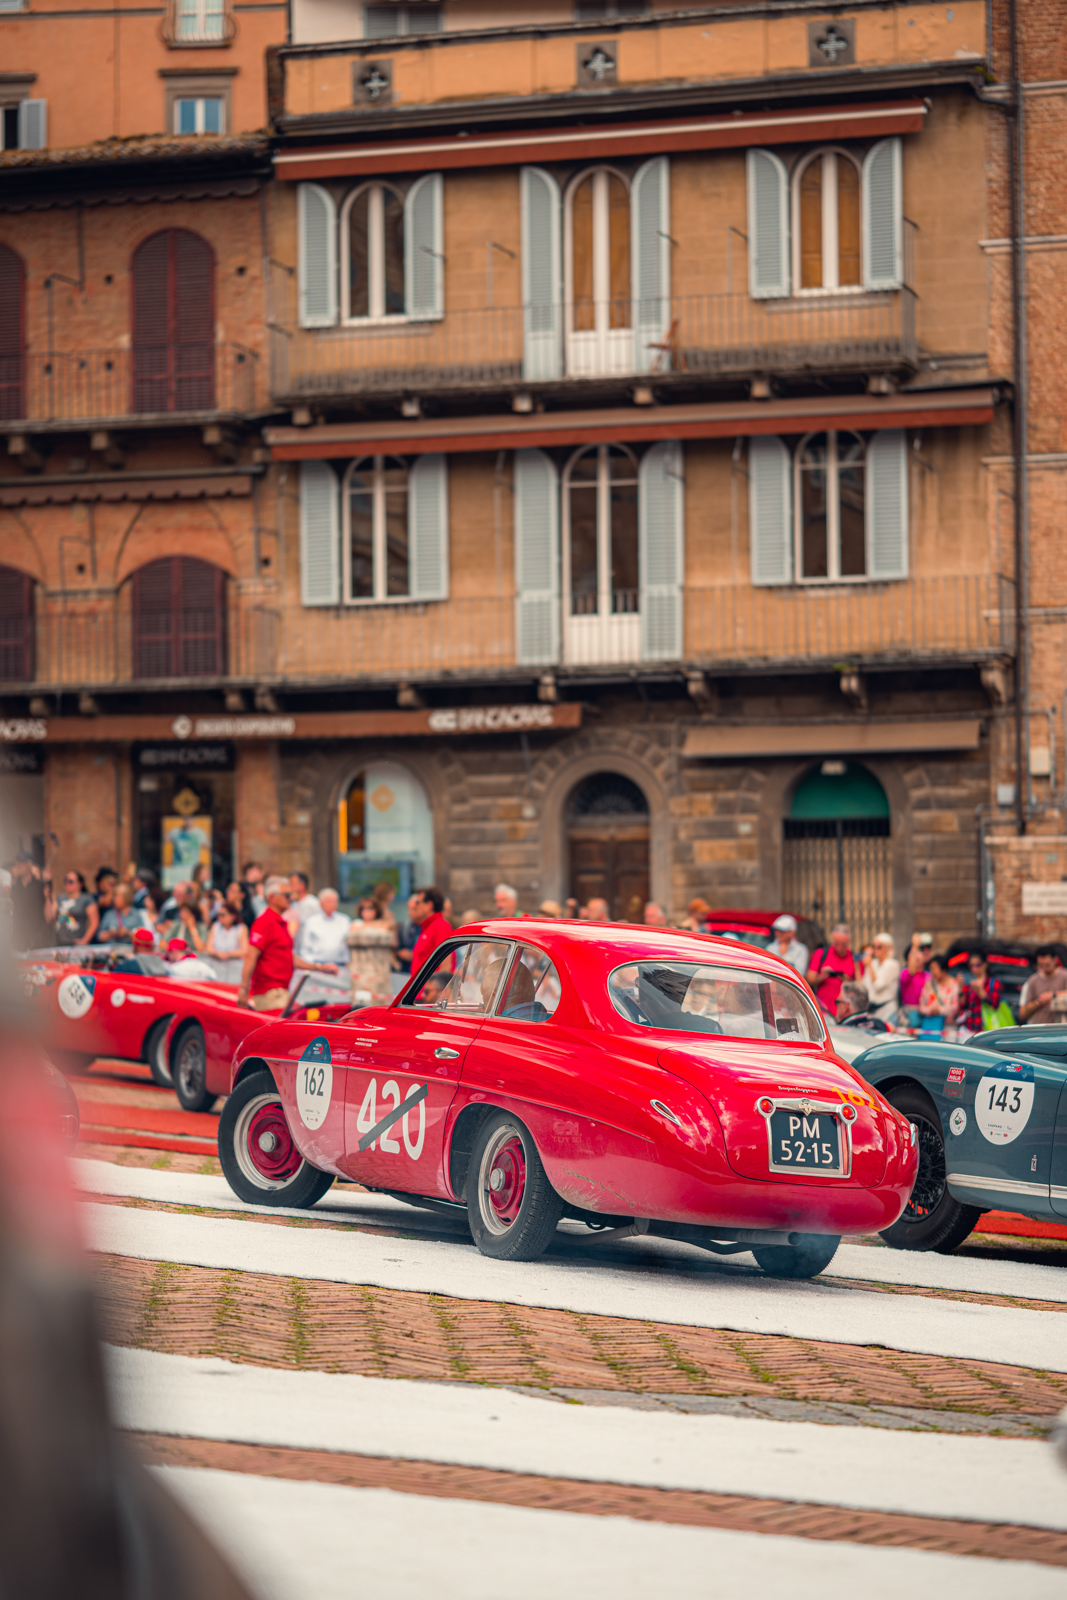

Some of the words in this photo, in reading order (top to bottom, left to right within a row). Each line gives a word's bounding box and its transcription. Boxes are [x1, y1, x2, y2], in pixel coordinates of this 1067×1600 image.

[303, 1067, 325, 1097] 162
[830, 1086, 882, 1113] 162
[988, 1084, 1023, 1113] 143
[356, 1077, 426, 1161] 420
[789, 1116, 820, 1139] PM
[780, 1140, 833, 1164] 52-15
